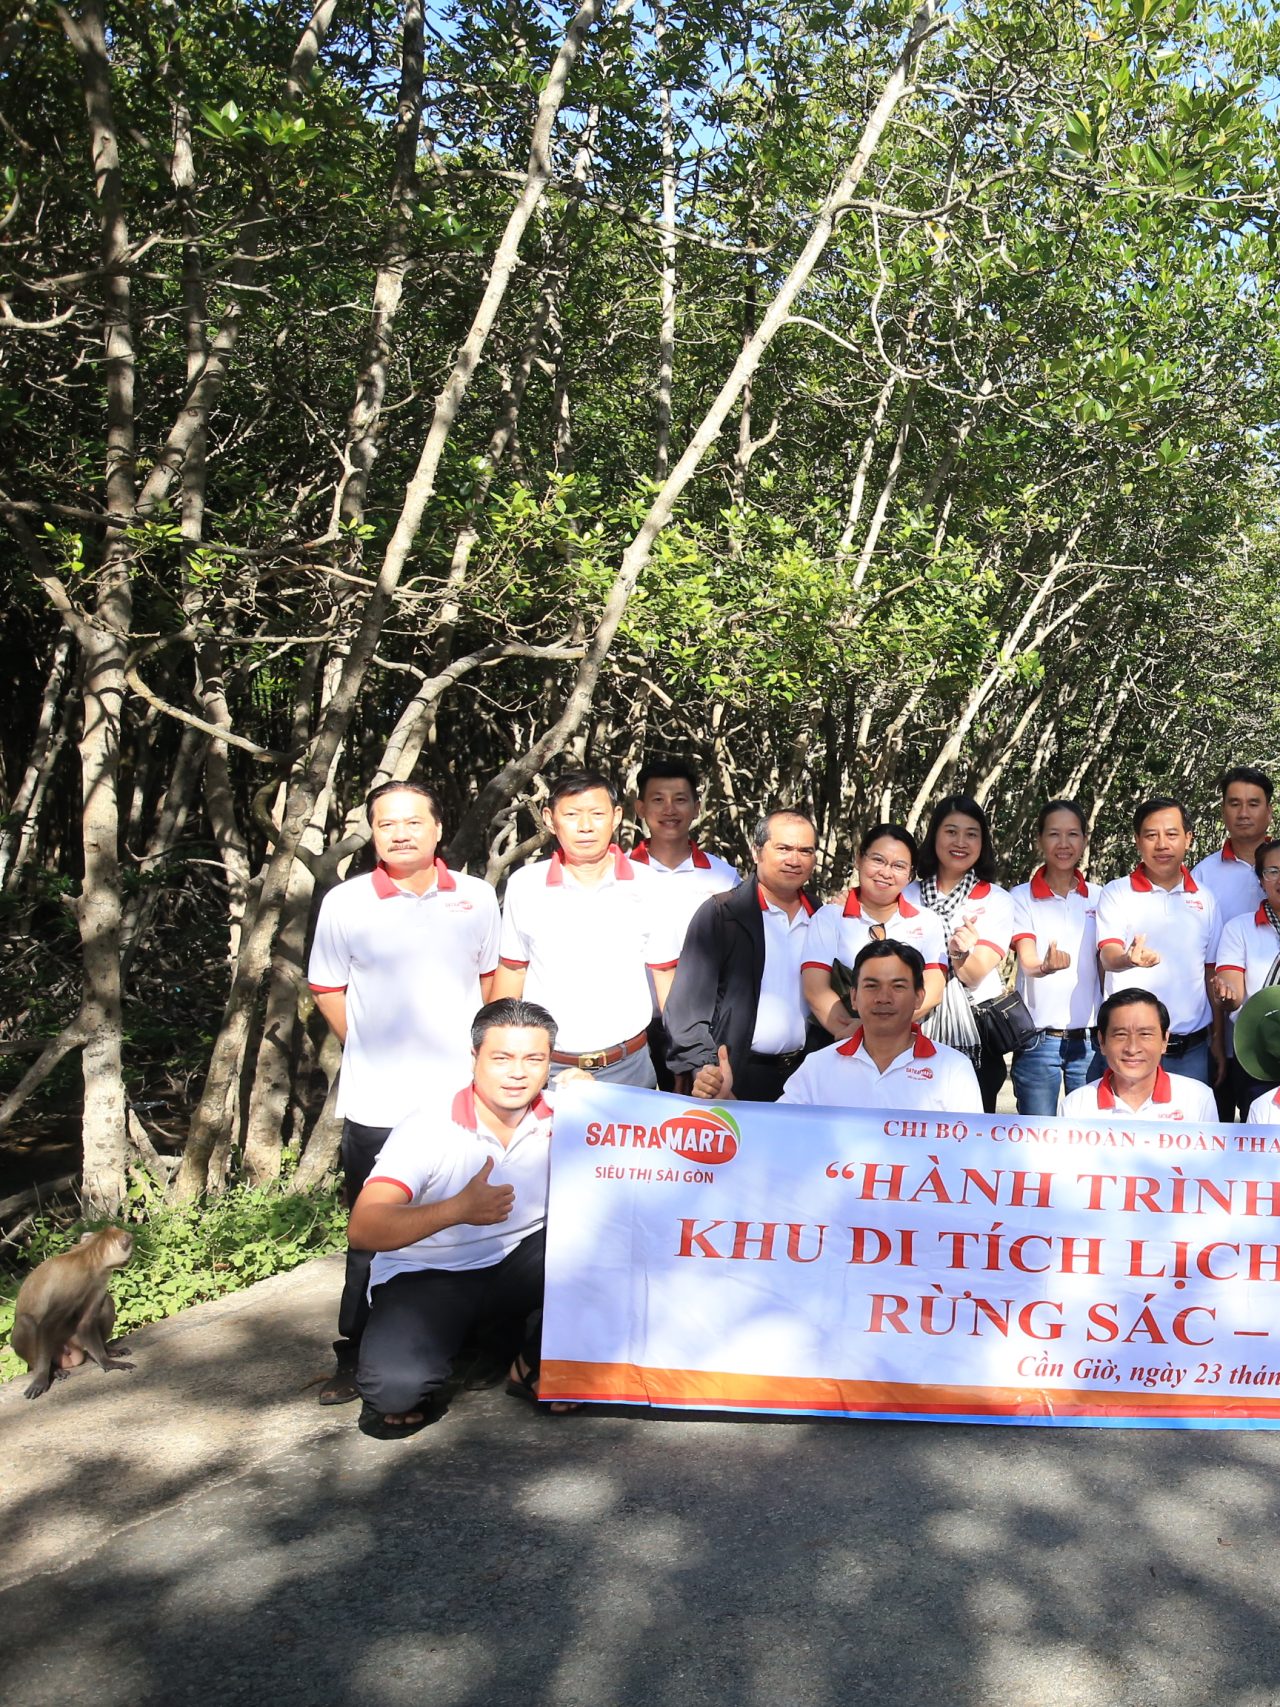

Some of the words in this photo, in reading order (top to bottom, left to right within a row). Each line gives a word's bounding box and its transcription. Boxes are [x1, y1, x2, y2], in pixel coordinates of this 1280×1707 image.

[586, 1121, 731, 1154] SATRAMART
[884, 1120, 927, 1138] CHI
[937, 1121, 968, 1142] BỘ
[991, 1124, 1058, 1144] CÔNG
[1068, 1128, 1136, 1148] ĐOÀN
[1159, 1132, 1226, 1151] ĐOÀN
[595, 1165, 627, 1180] SIÊU
[629, 1168, 652, 1183] THỊ
[656, 1167, 680, 1182] SÀI
[683, 1169, 714, 1184] GÒN
[825, 1155, 1056, 1208] “HÀNH
[675, 1218, 828, 1262] KHU
[846, 1227, 919, 1267] DI
[936, 1222, 1104, 1276] TÍCH
[864, 1283, 1068, 1340] RỪNG
[1084, 1293, 1219, 1346] SÁC
[1016, 1354, 1069, 1379] Cần
[1073, 1355, 1122, 1384] Giờ,
[1128, 1363, 1189, 1388] ngày
[1194, 1362, 1223, 1385] 23
